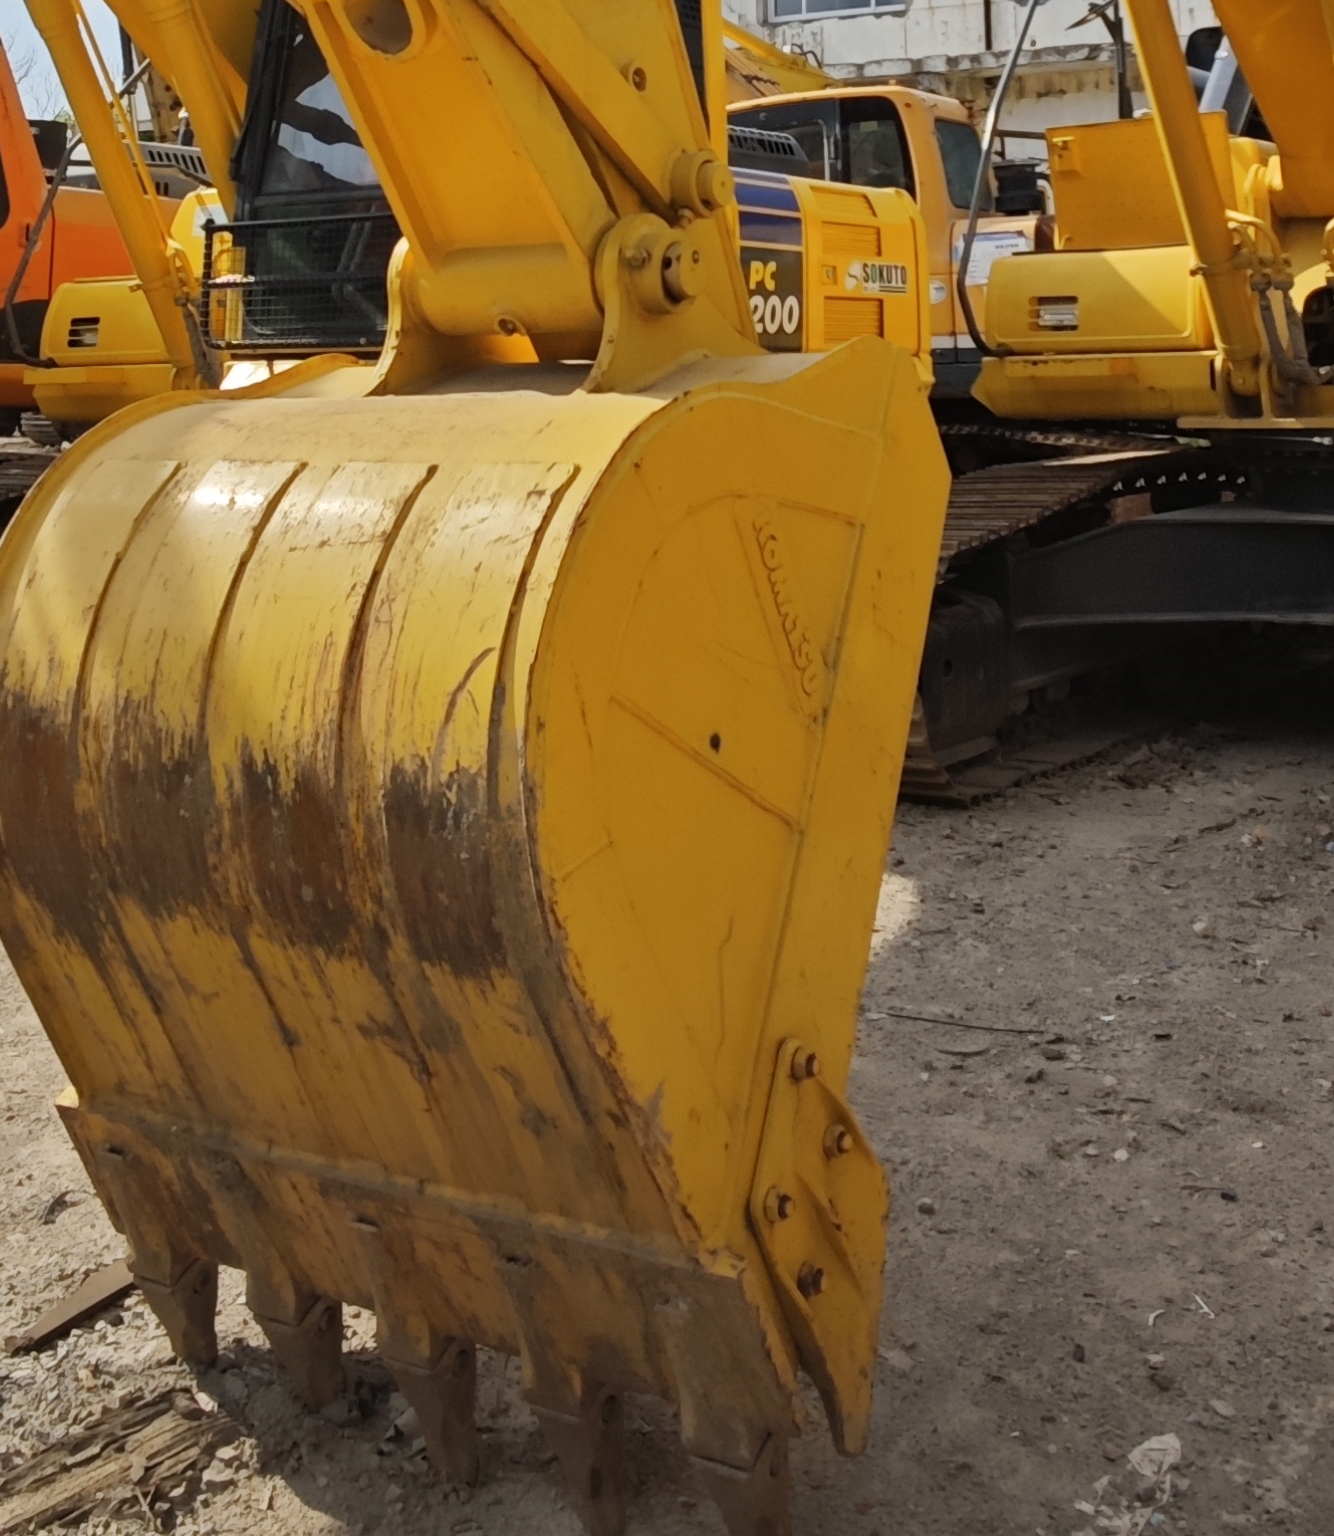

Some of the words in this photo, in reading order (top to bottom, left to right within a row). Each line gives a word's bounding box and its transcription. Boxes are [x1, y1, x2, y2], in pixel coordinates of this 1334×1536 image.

[749, 260, 777, 292] PC
[862, 262, 908, 286] SOKUTO
[749, 295, 800, 334] 200
